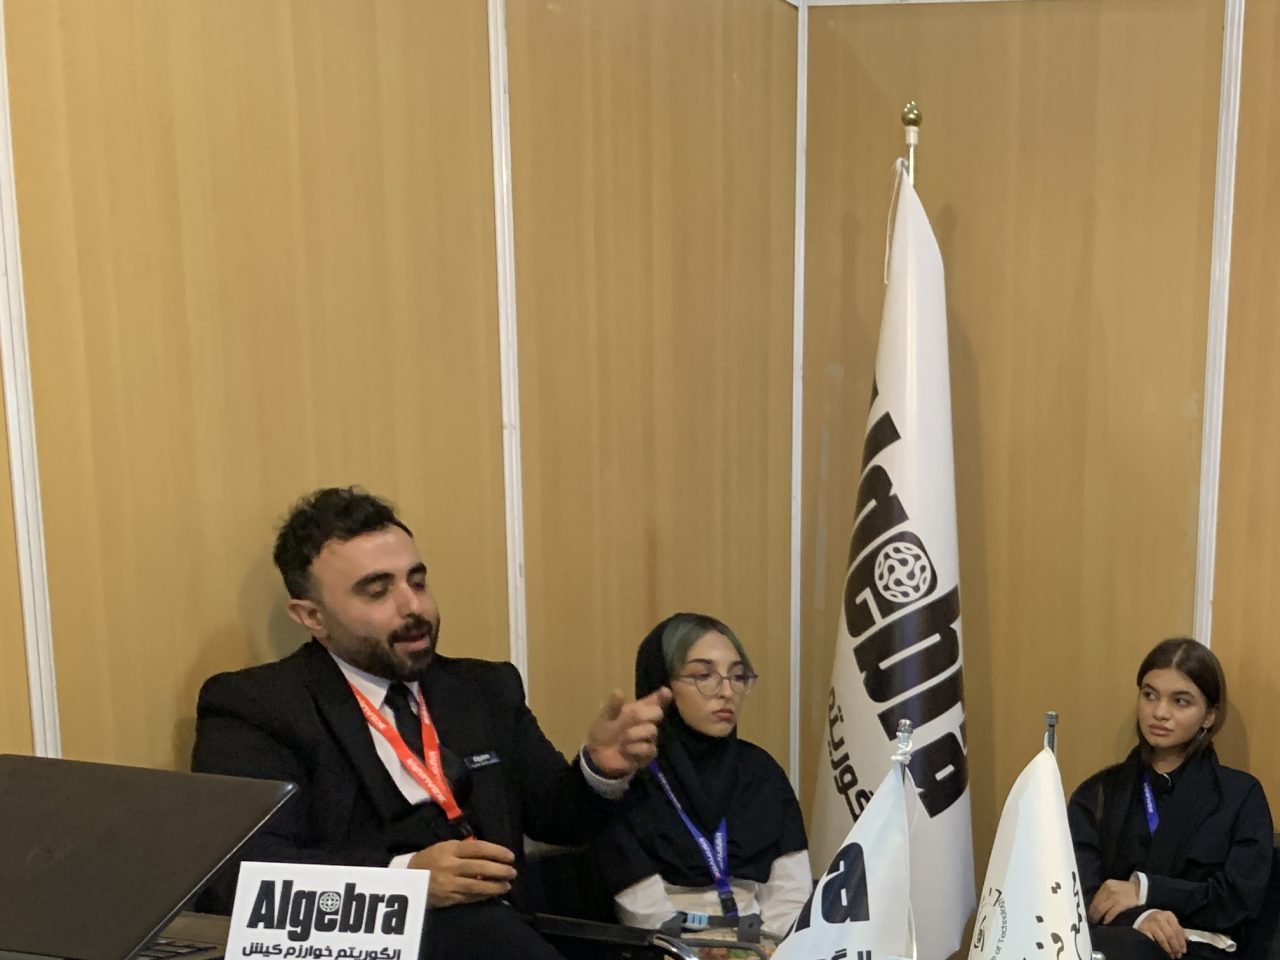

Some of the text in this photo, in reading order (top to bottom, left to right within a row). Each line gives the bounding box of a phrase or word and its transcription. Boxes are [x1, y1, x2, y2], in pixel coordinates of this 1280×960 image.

[843, 370, 970, 819] lgebra
[246, 879, 409, 942] Algebra
[242, 942, 283, 957] کیش
[283, 945, 333, 960] خوارزم
